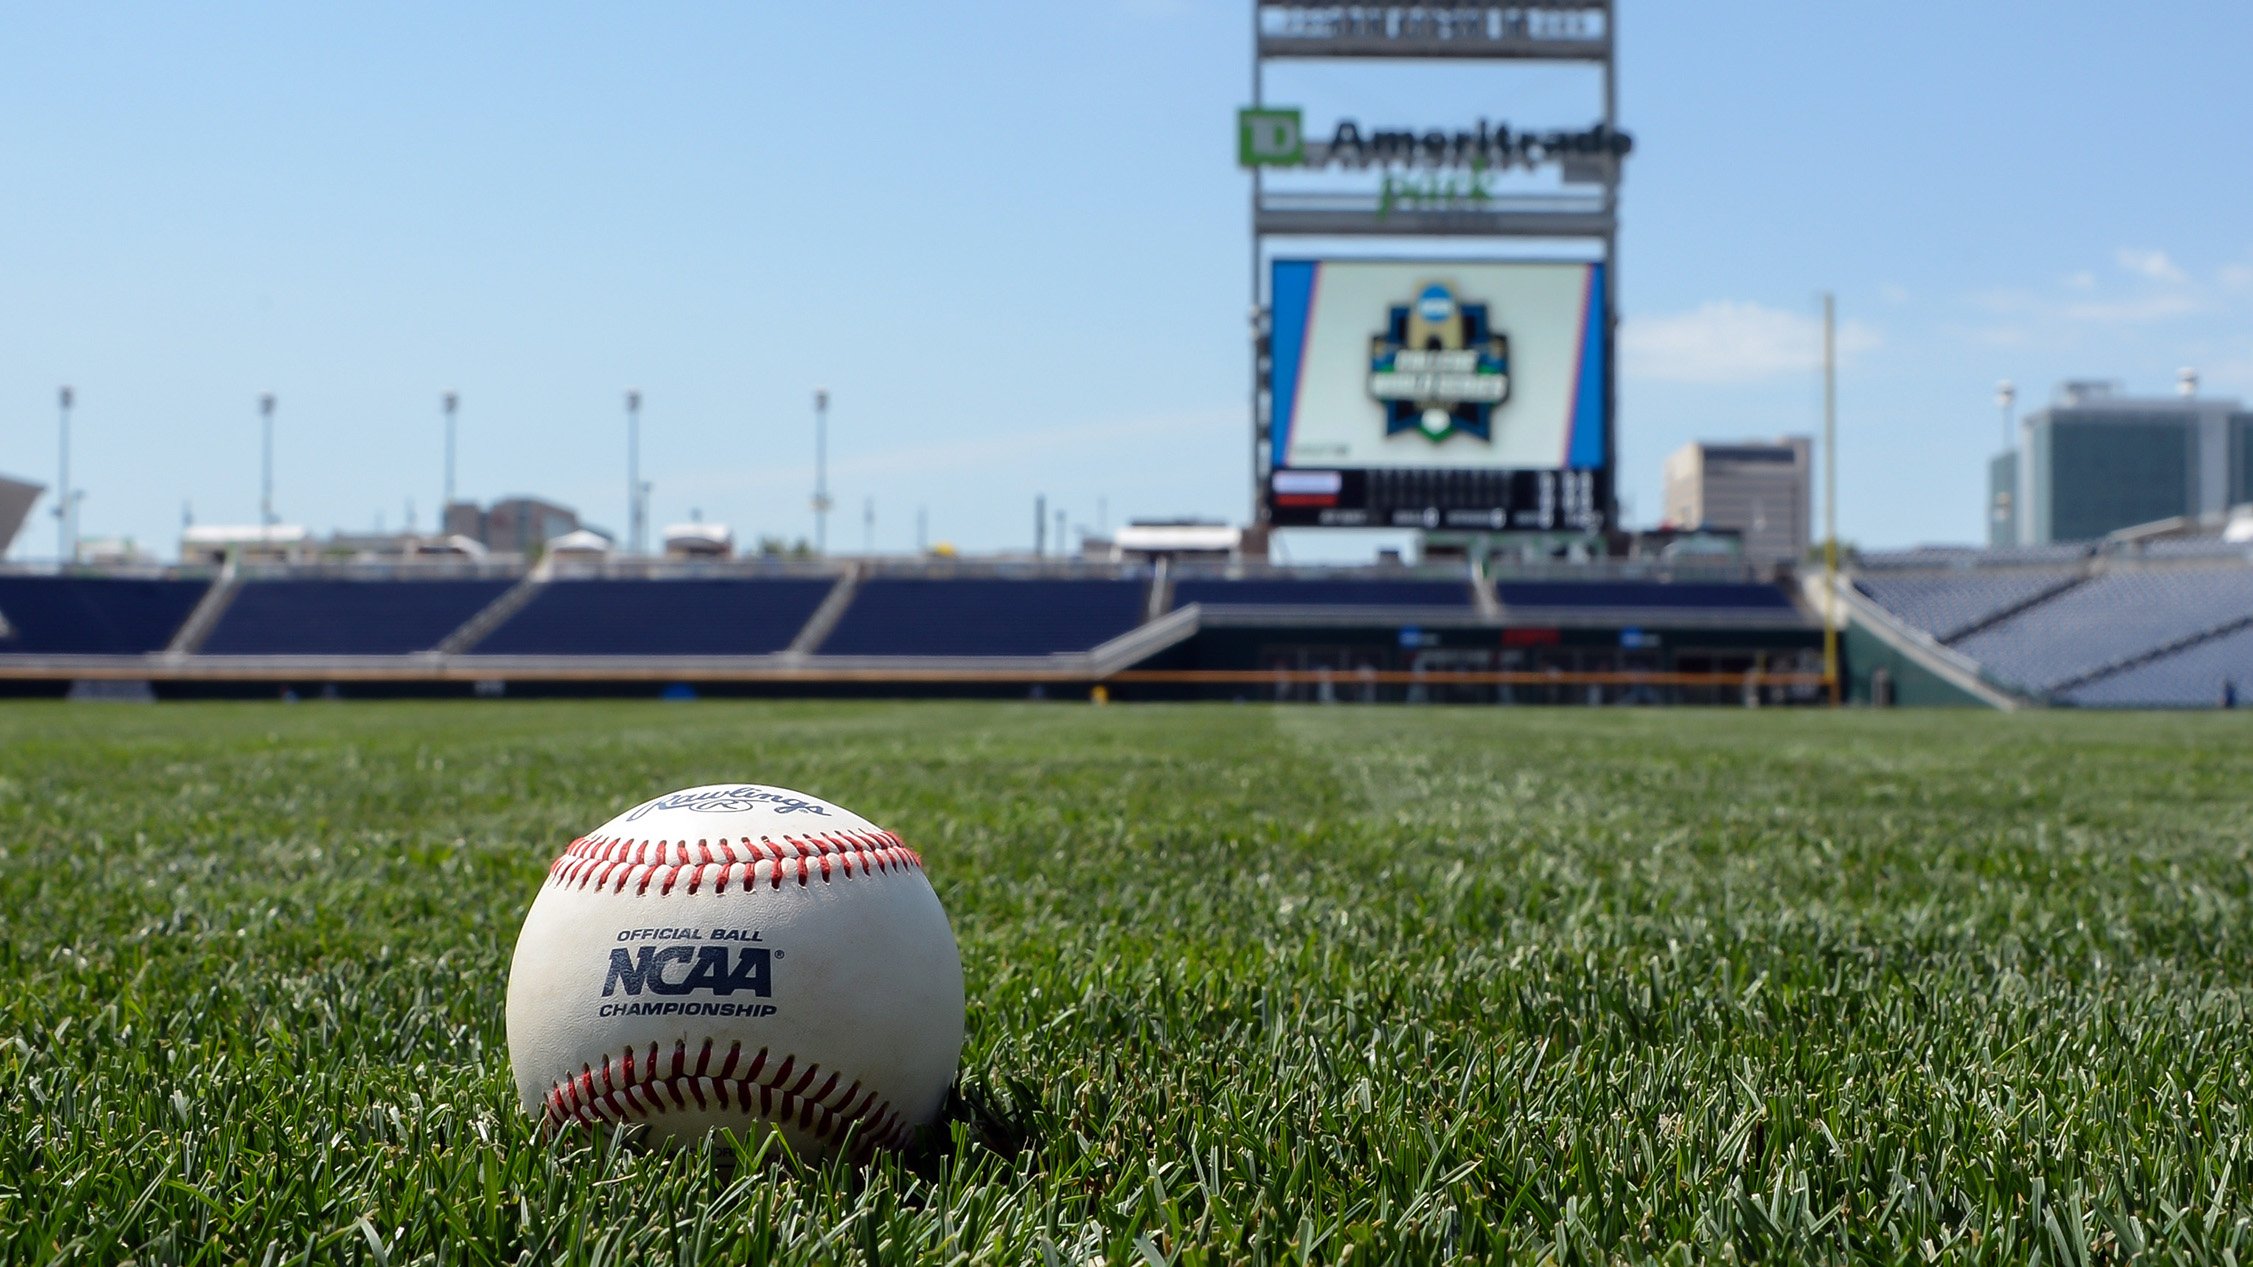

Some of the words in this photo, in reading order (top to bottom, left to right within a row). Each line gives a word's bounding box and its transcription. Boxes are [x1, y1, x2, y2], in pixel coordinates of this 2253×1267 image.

[1245, 115, 1300, 159] TD
[1328, 117, 1634, 159] Ameritrade
[1376, 155, 1494, 220] park
[626, 787, 832, 822] Rawlings
[617, 929, 702, 942] OFFICIAL
[710, 930, 763, 942] BALL
[600, 1002, 777, 1017] CHAMPIONSHIP
